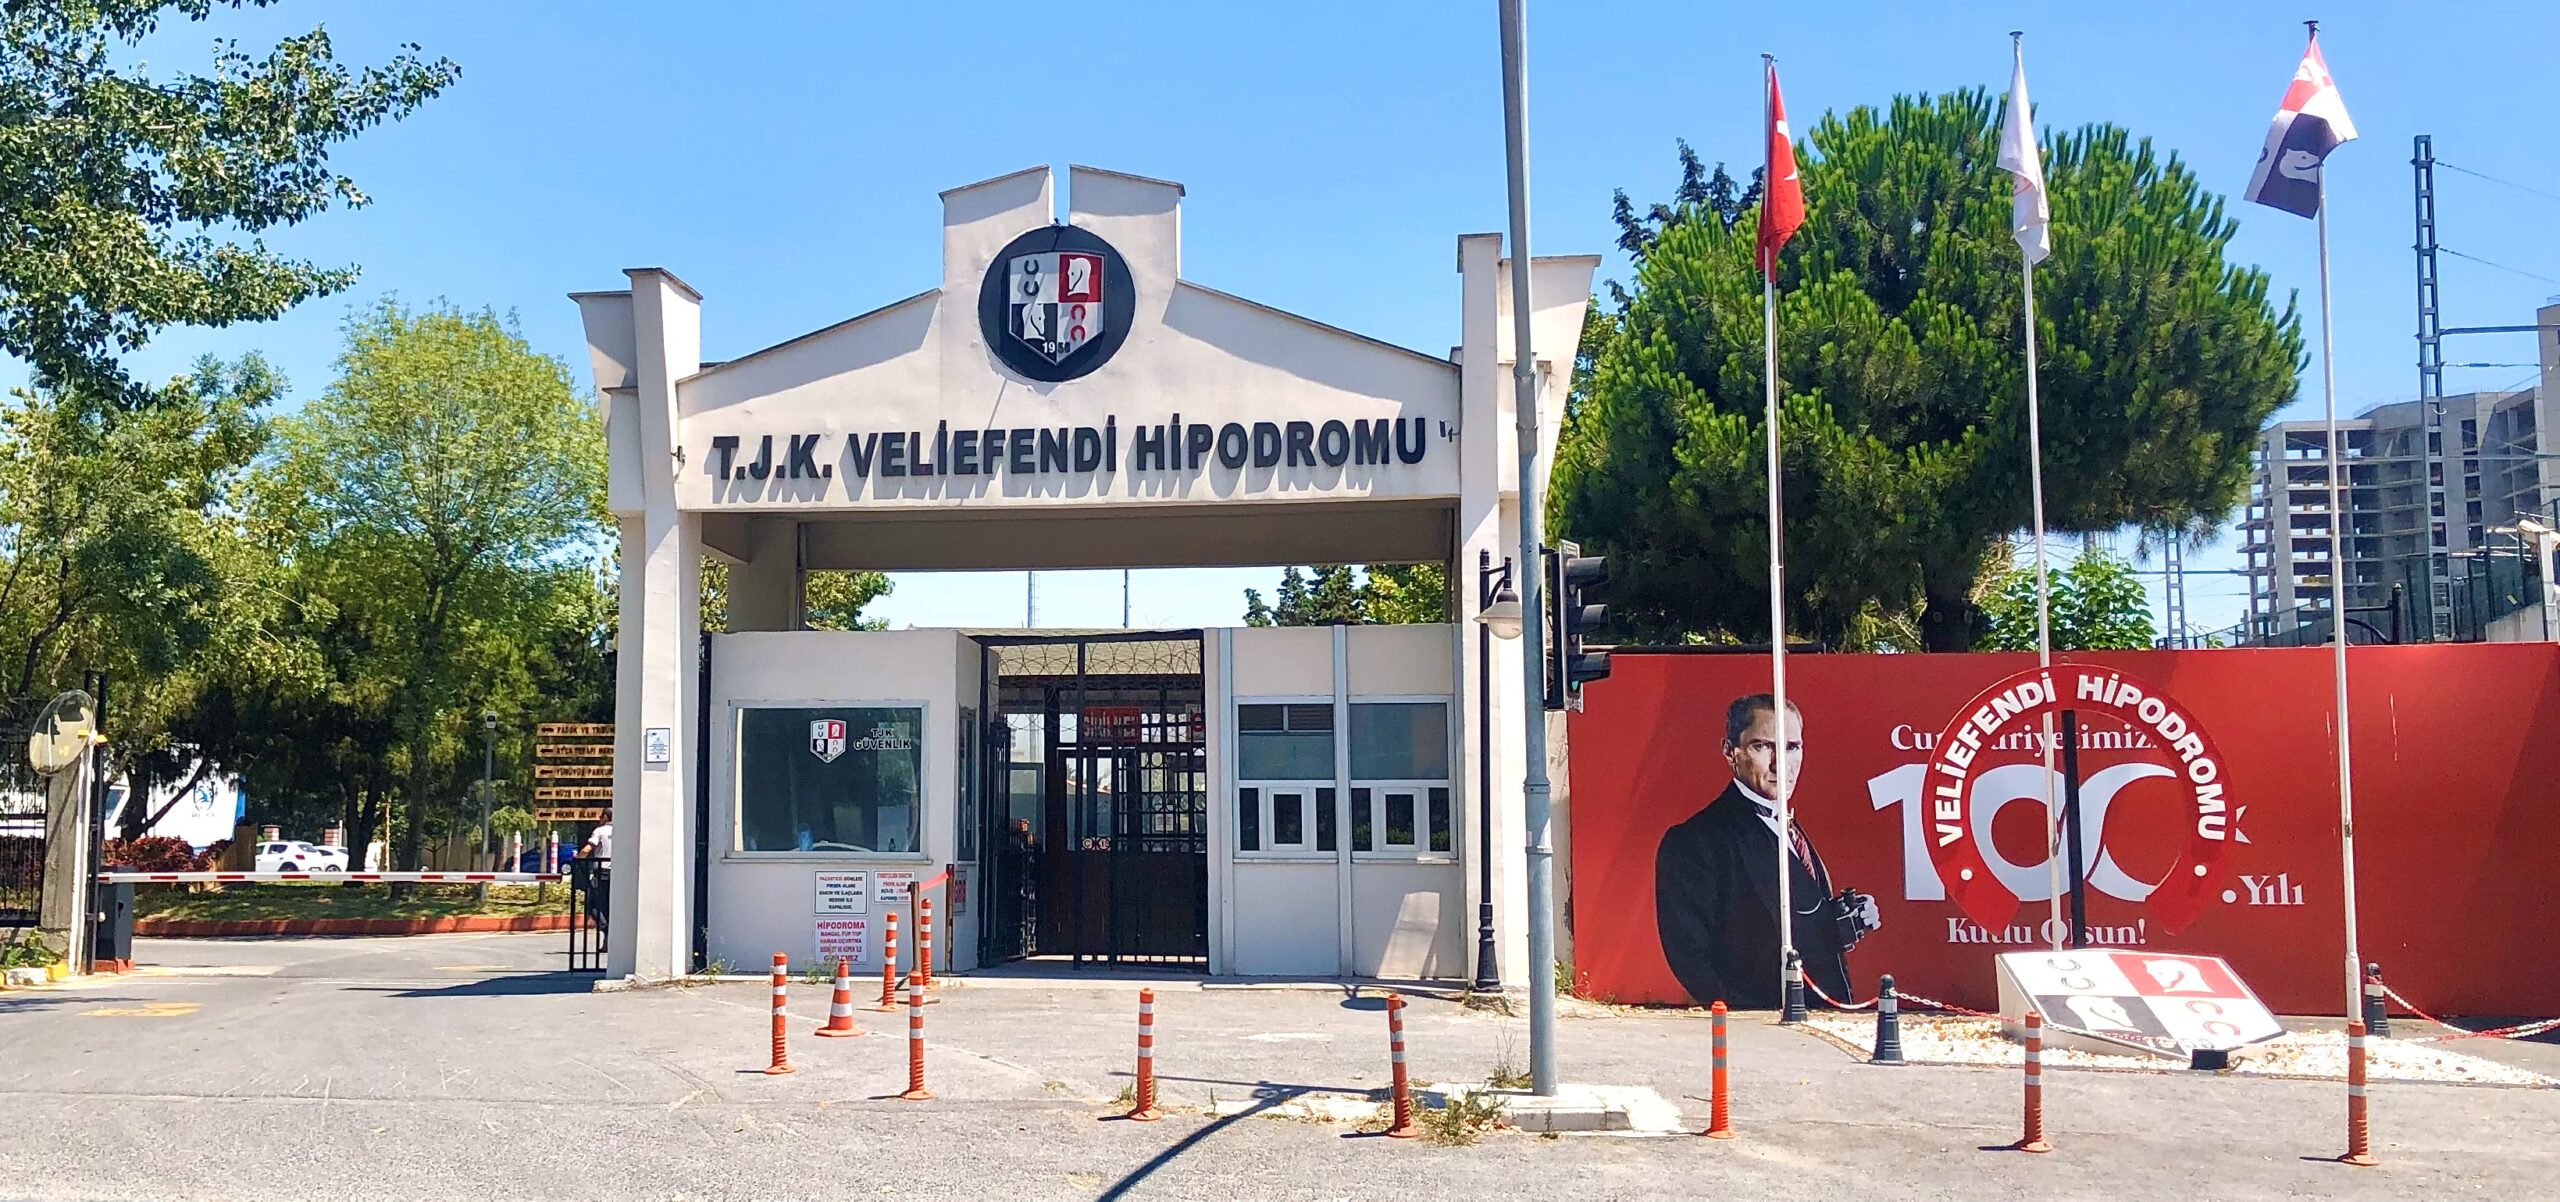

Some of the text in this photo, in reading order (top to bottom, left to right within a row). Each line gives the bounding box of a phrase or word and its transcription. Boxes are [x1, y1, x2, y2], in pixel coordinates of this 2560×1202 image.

[713, 412, 1426, 481] T.J.K. VELİEFENDİ HİPODROMU
[871, 728, 894, 738] TJK
[1935, 671, 2227, 847] VELİEFENDİ HİPODROMU
[817, 920, 866, 930] HİPODROMA
